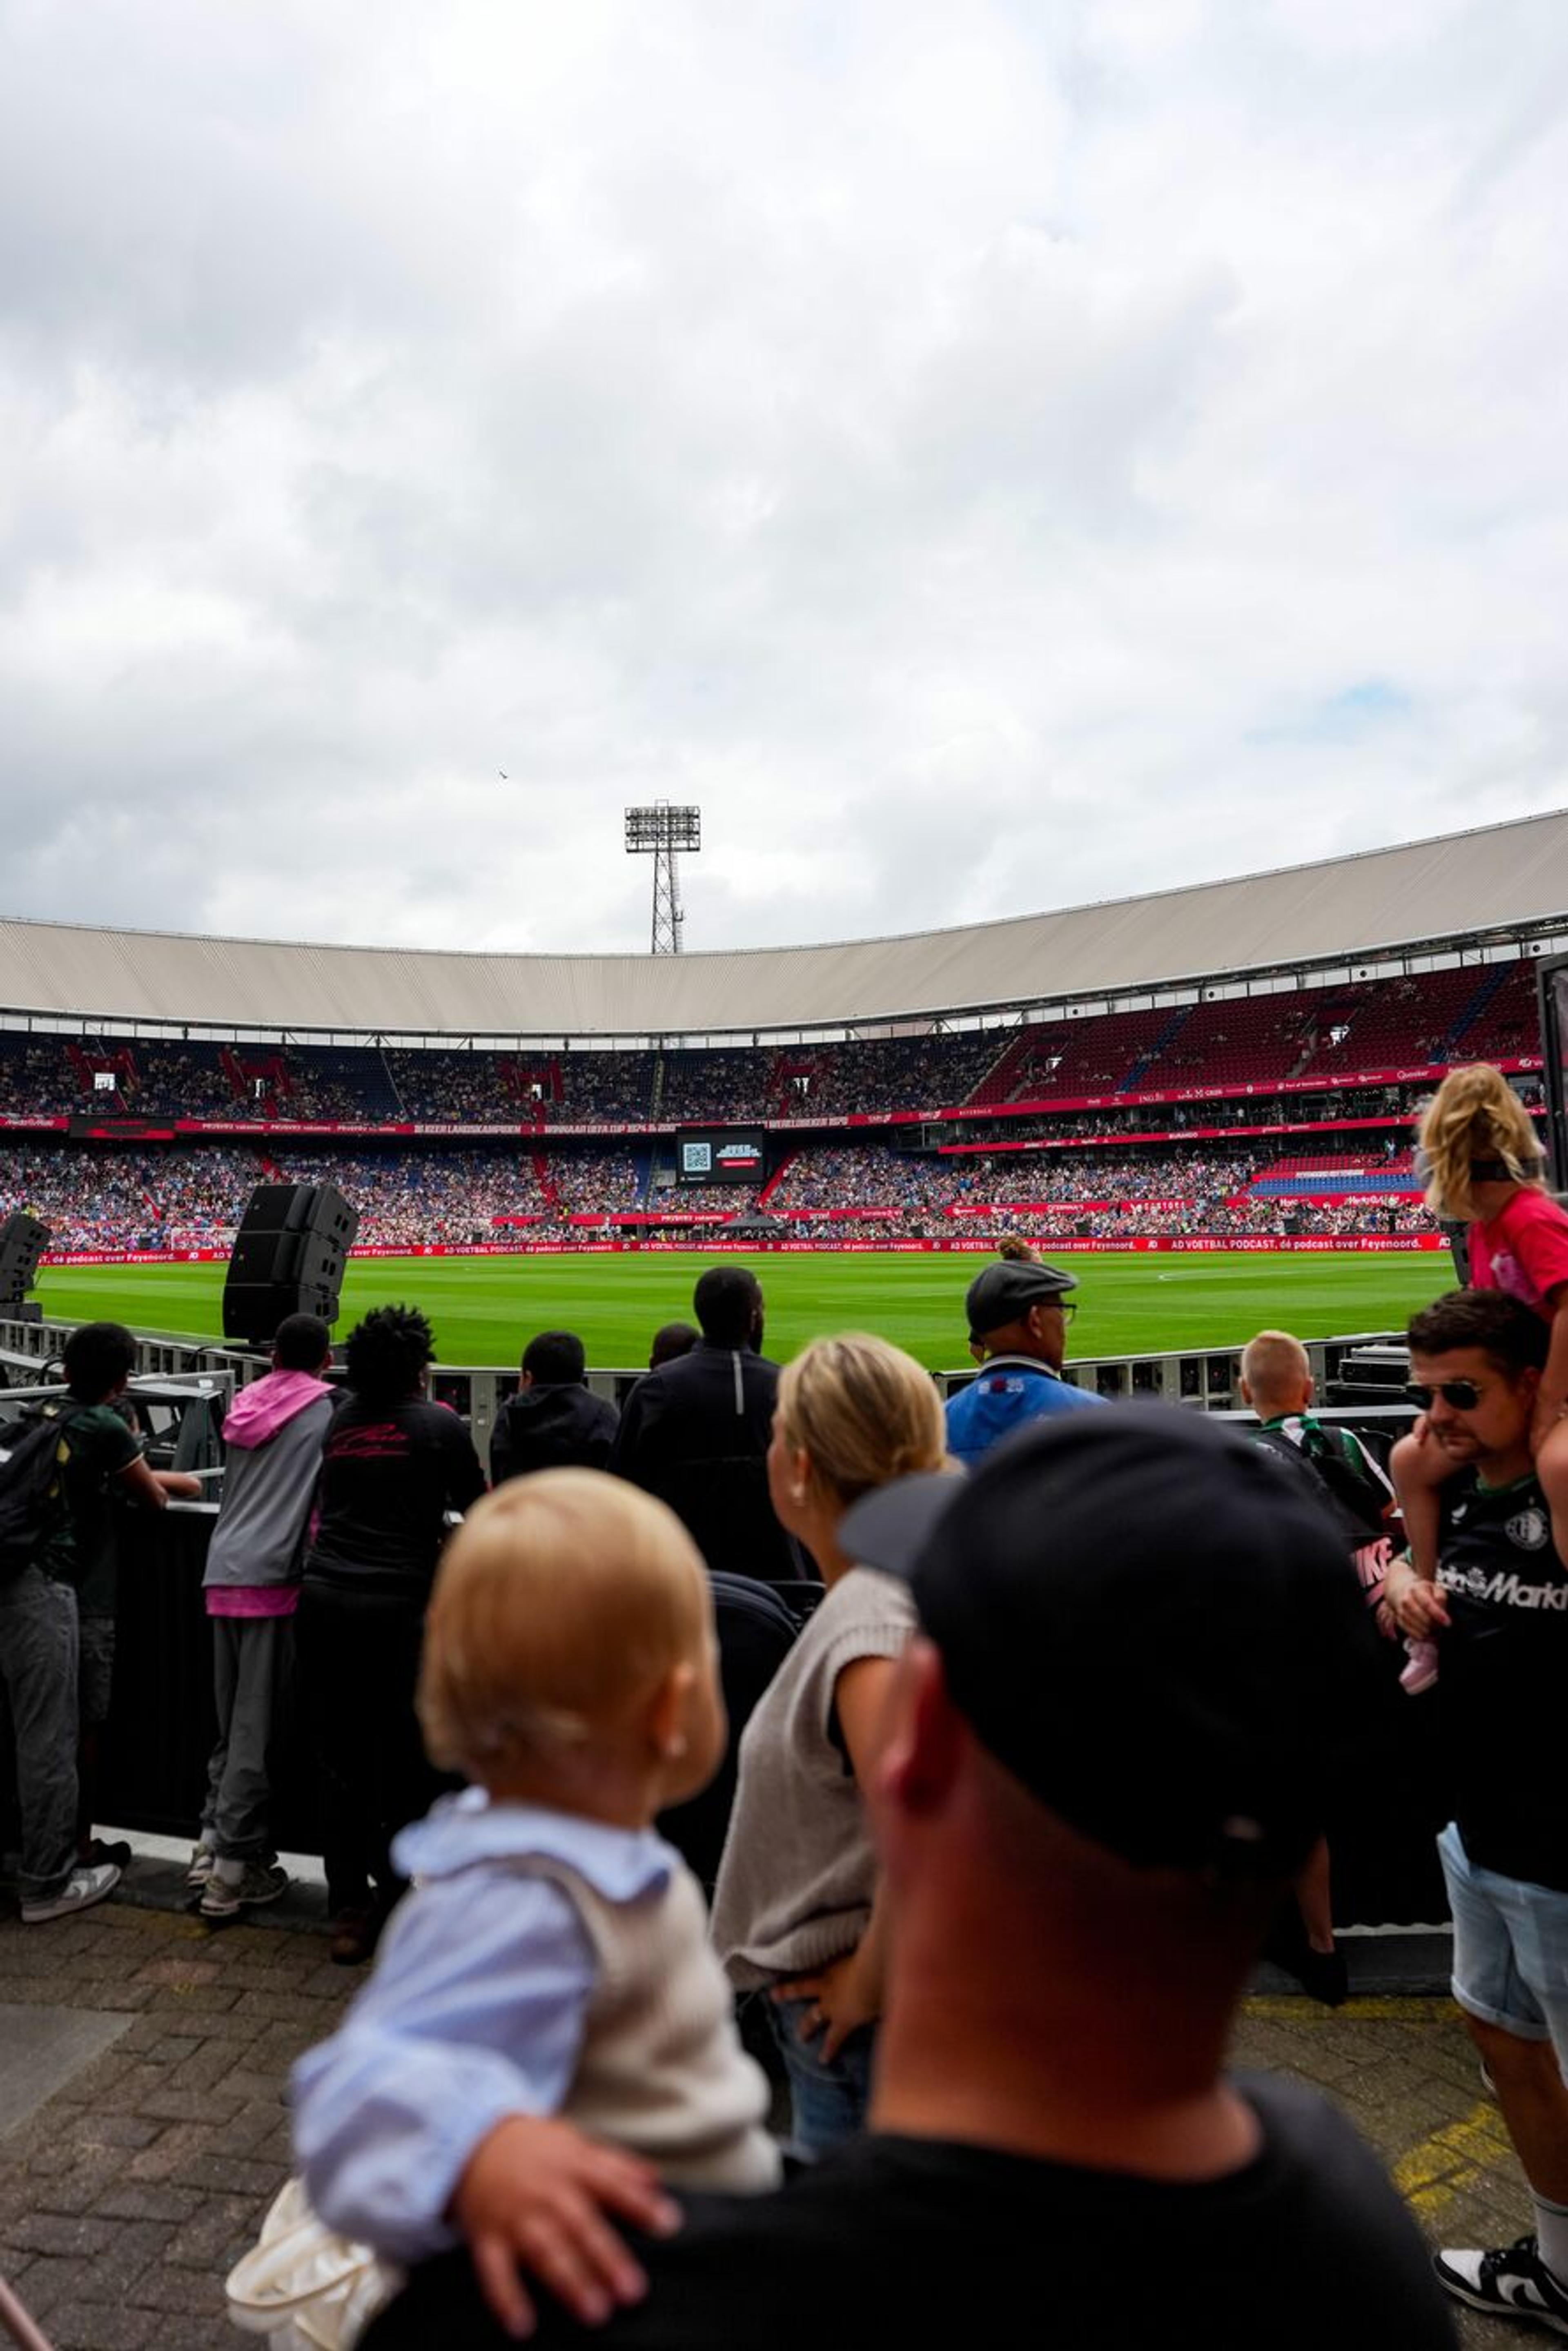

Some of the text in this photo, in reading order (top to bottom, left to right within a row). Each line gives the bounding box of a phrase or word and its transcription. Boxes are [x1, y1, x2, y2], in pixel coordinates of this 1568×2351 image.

[1042, 1242, 1071, 1251] podcast
[1171, 1240, 1185, 1249] AD
[1185, 1240, 1227, 1249] VOETBAL
[1229, 1239, 1278, 1250] PODCAST,
[1294, 1240, 1333, 1251] podcast
[1336, 1240, 1358, 1248] over
[1361, 1238, 1422, 1250] Feyenoord.
